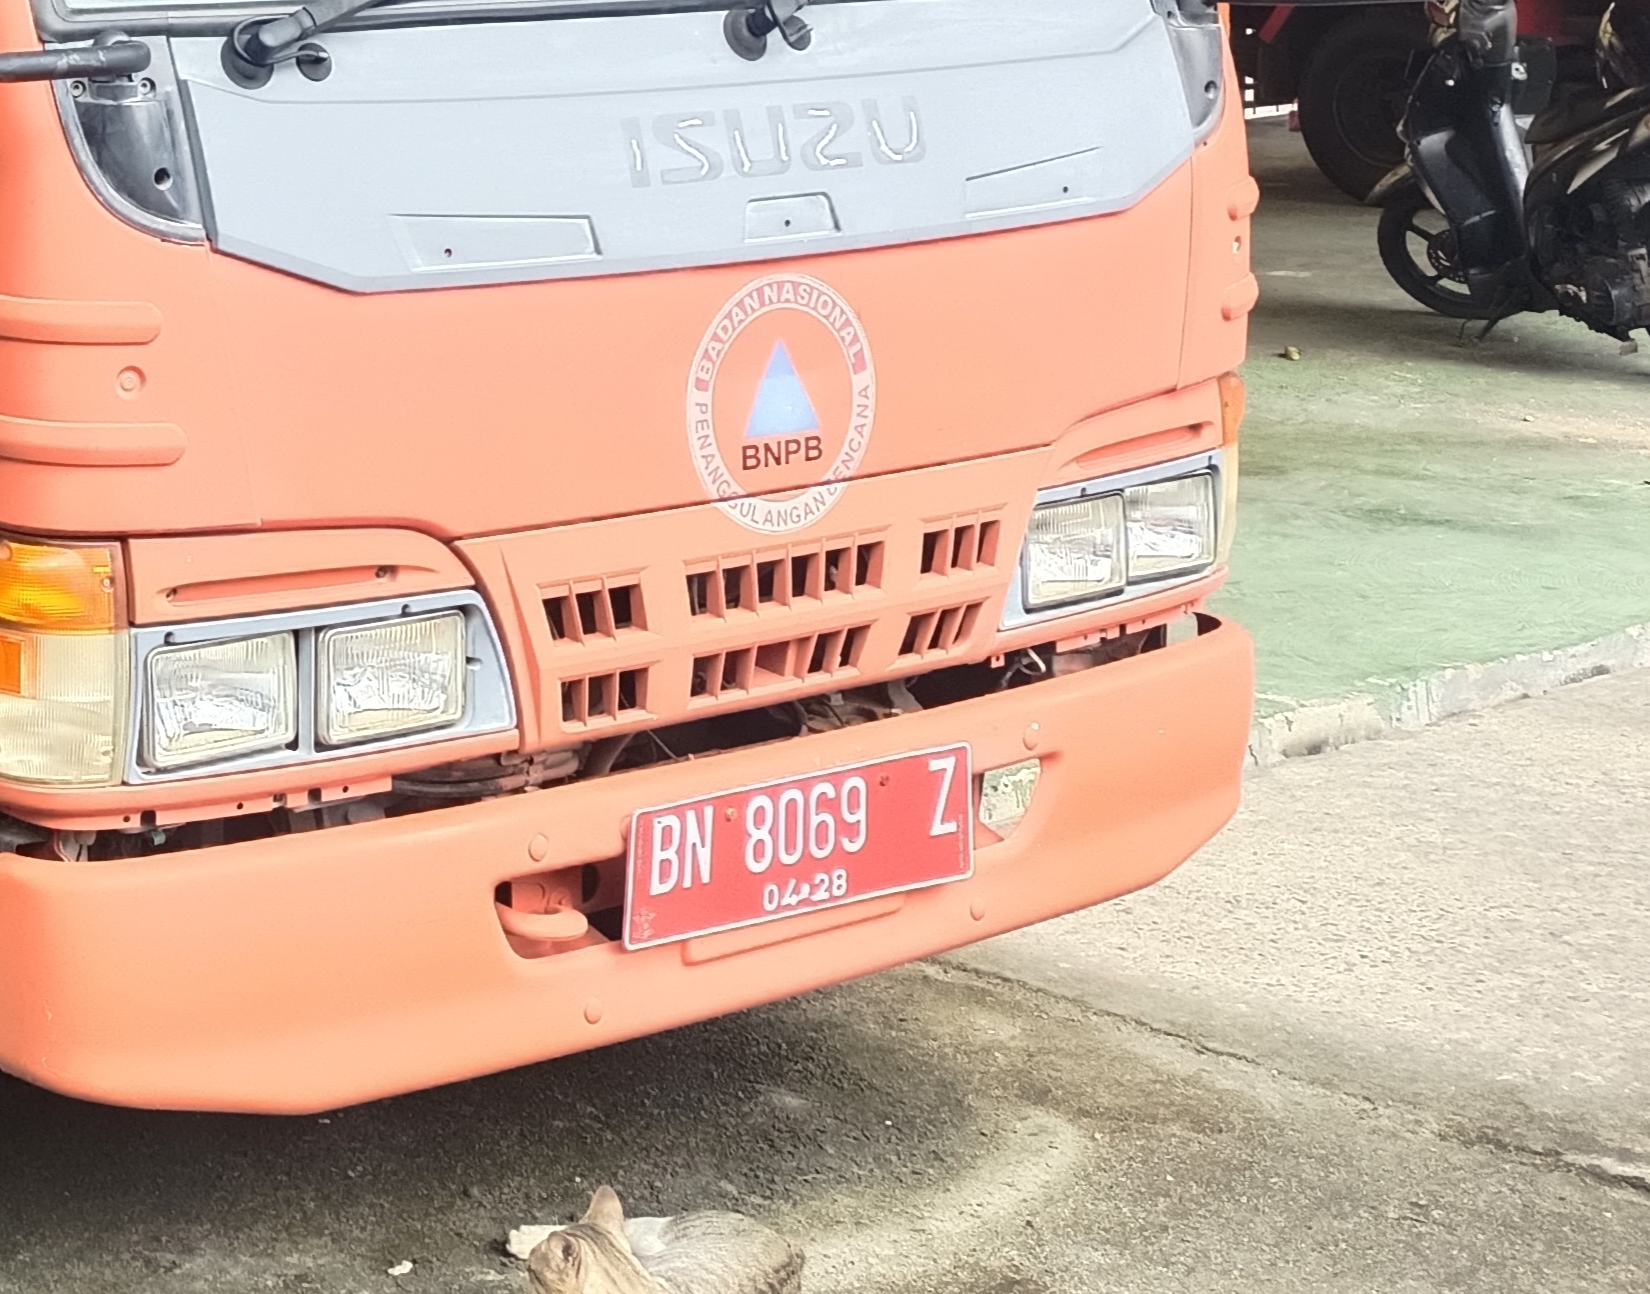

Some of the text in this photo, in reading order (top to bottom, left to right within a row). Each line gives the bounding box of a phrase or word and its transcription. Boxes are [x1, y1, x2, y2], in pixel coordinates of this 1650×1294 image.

[620, 95, 927, 189] ISUZU
[698, 282, 864, 381] BADAN NASIONAL
[741, 435, 824, 471] BNPB
[649, 804, 714, 896] BN
[744, 776, 868, 874] 8069
[926, 755, 958, 838] Z
